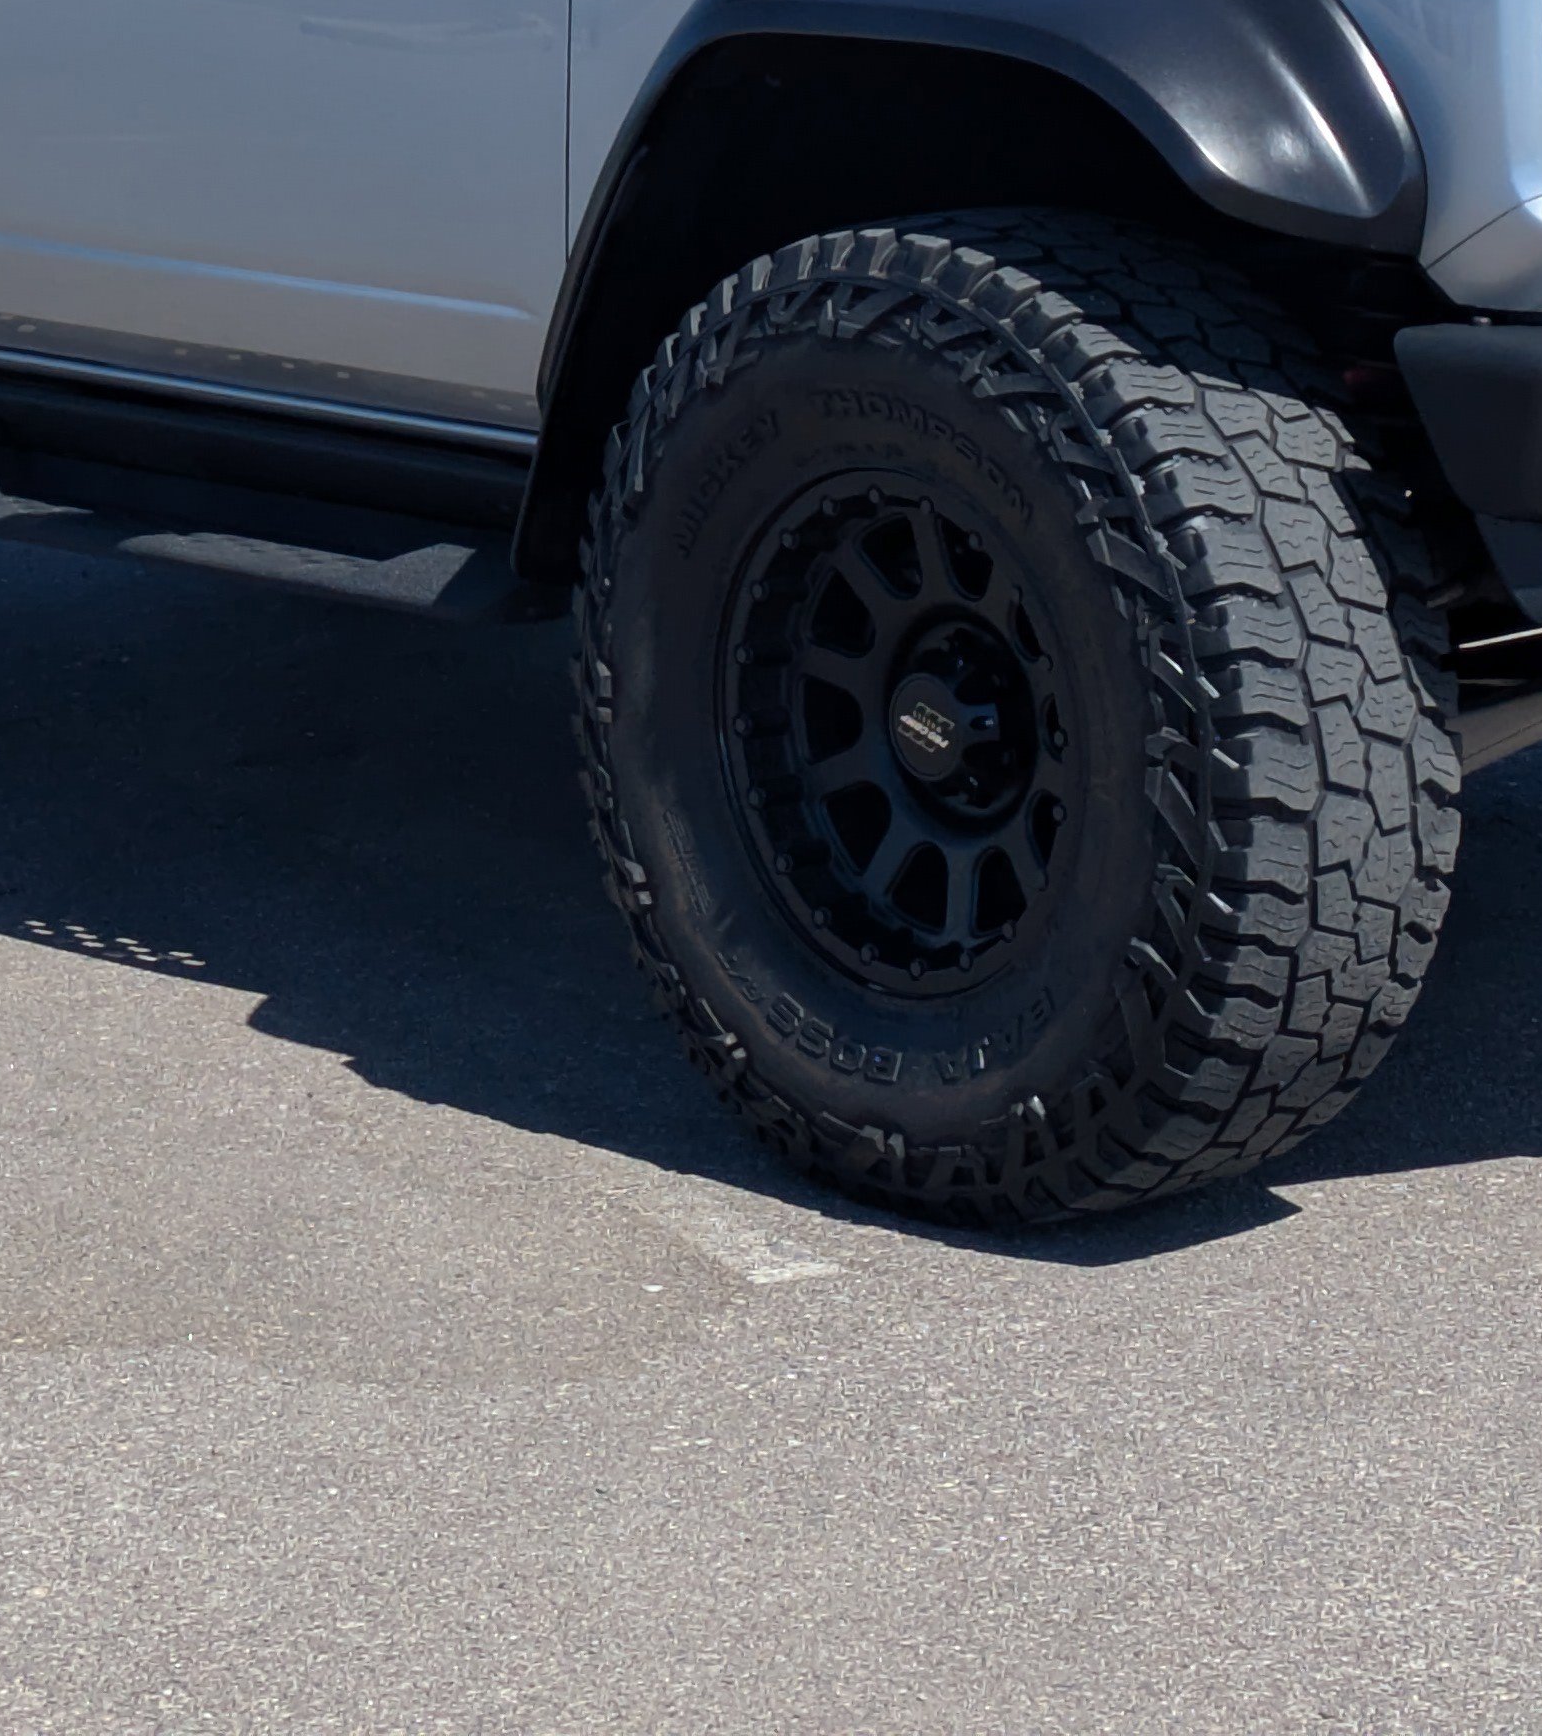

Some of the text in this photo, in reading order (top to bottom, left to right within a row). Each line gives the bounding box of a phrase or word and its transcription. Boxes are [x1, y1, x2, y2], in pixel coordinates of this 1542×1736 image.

[671, 387, 1035, 559] MICKEY THOMPSON
[765, 991, 905, 1085] BOSS
